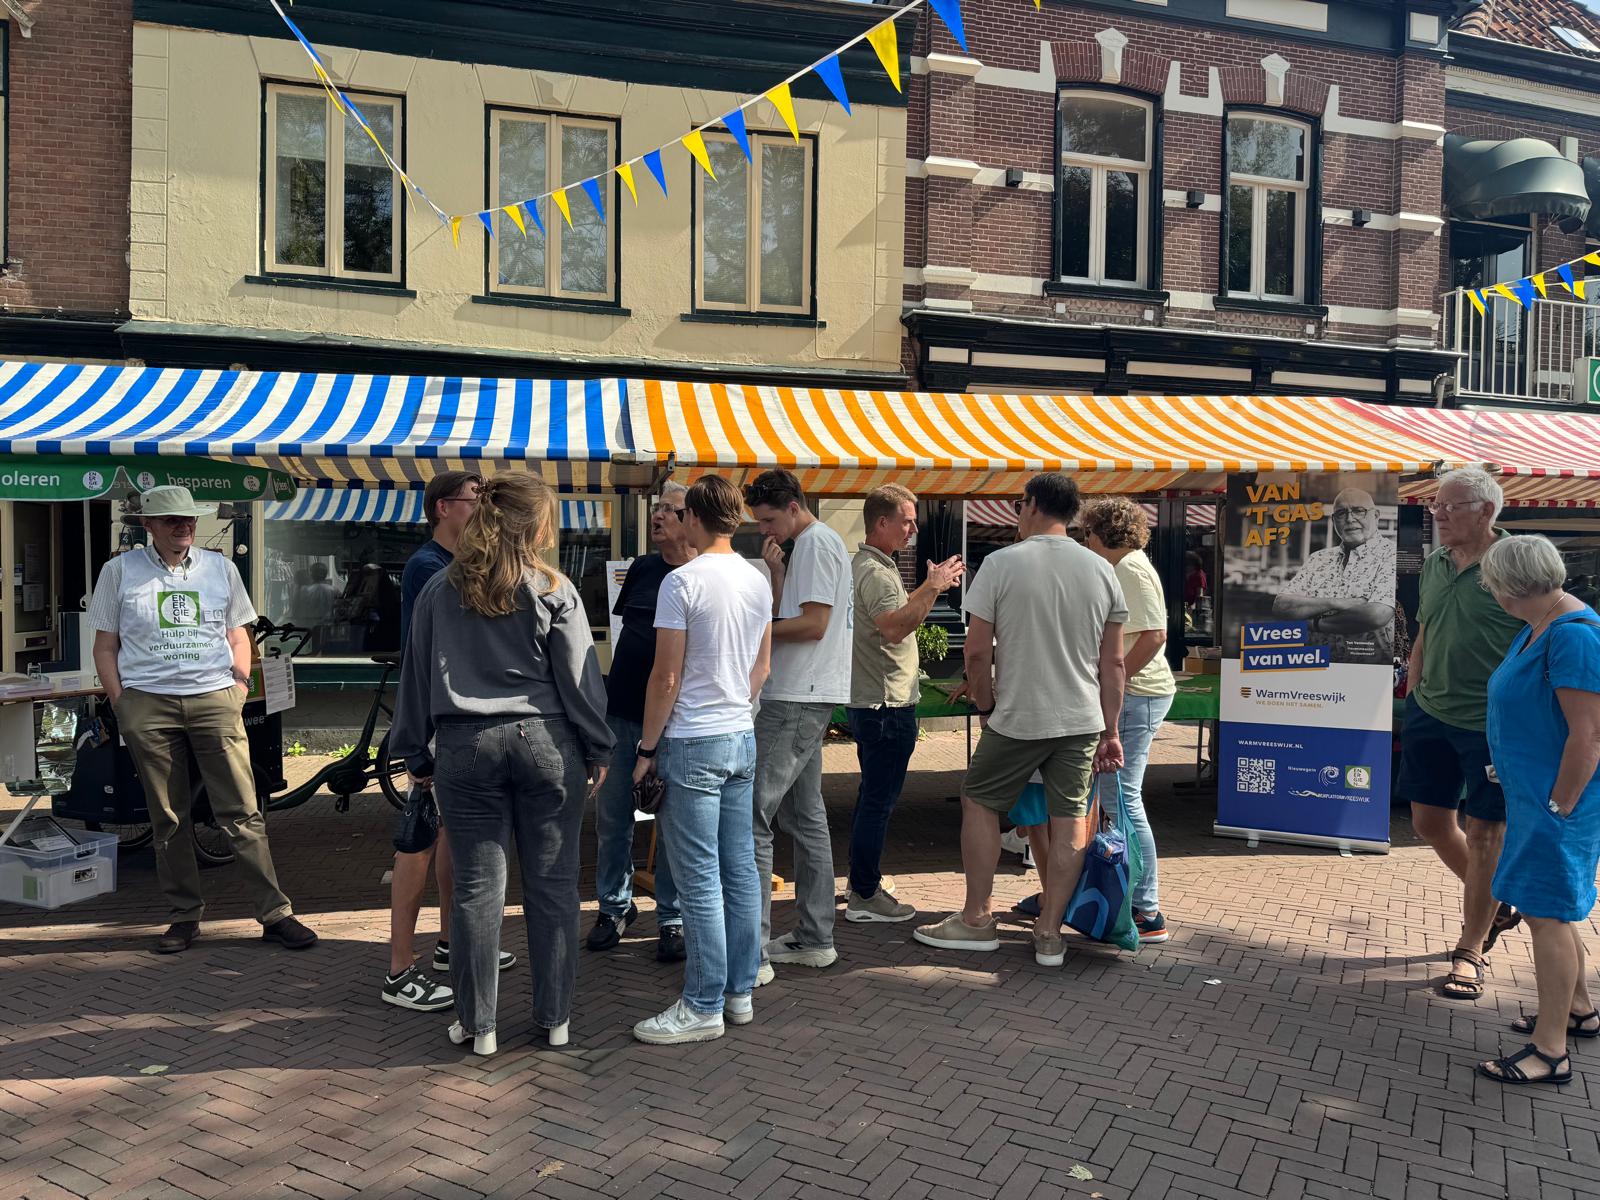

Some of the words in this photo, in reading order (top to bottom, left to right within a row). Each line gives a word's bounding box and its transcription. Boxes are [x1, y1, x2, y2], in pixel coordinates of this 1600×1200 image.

[1, 470, 60, 486] oleren
[166, 472, 231, 491] besparen
[1246, 481, 1300, 503] VAN
[1272, 502, 1325, 523] GAS
[1245, 526, 1291, 548] AF?
[172, 594, 186, 602] EN
[172, 601, 186, 609] ER
[172, 609, 190, 617] GIE
[161, 630, 185, 638] Hulp
[187, 629, 198, 639] bij
[1249, 626, 1302, 641] Vrees
[148, 642, 214, 651] verduurzamen
[163, 652, 200, 661] woning
[1248, 654, 1283, 666] van
[1287, 648, 1326, 665] wel.
[1255, 688, 1346, 704] WarmVreeswijk
[1238, 739, 1304, 749] WARMVREESWIJK.NL
